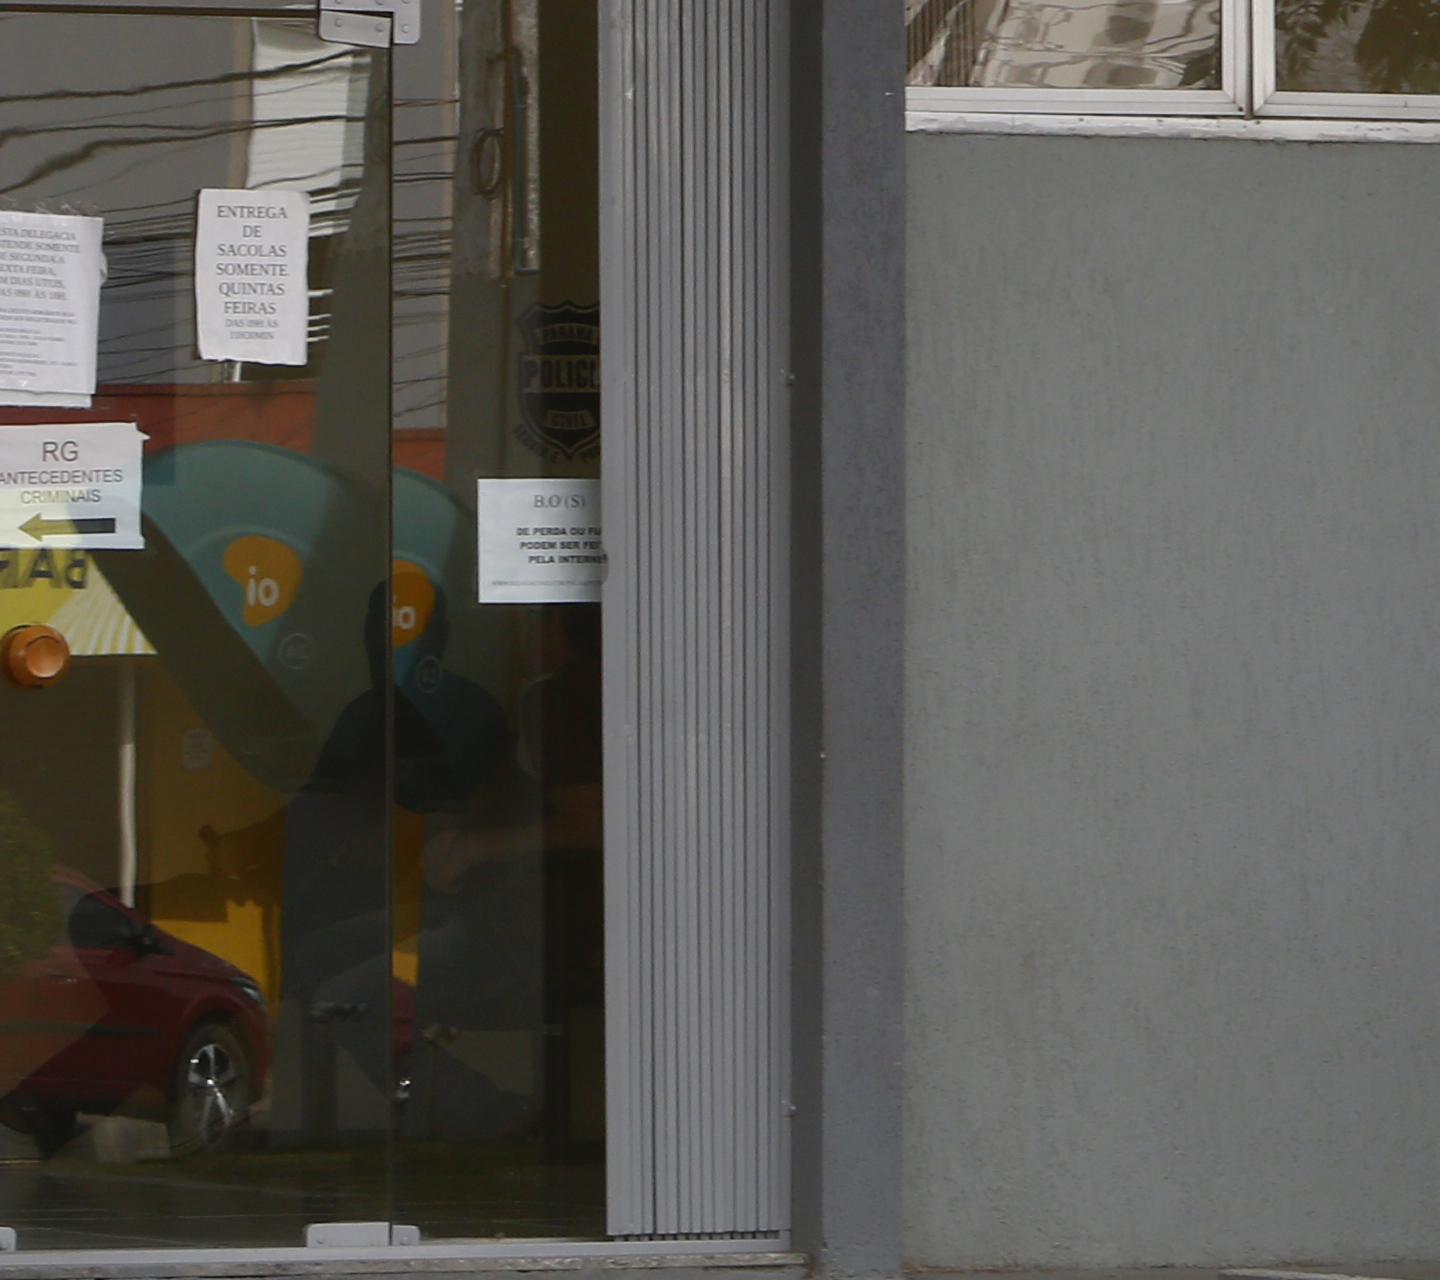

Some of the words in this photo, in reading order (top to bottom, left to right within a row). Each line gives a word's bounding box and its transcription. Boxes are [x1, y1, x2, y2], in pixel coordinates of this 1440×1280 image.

[217, 205, 288, 219] ENTREGA
[242, 225, 262, 238] DE
[217, 243, 287, 257] SACOLAS
[215, 263, 289, 276] SOMENTE
[218, 282, 286, 297] QUINTAS
[224, 301, 276, 315] FEIRAS
[42, 440, 79, 462] RG
[20, 489, 102, 504] CRIMINAIS
[516, 527, 530, 536] DE
[532, 527, 567, 536] PERDA
[520, 541, 557, 550] PODEM
[560, 541, 579, 550] SER
[528, 555, 554, 564] PELA
